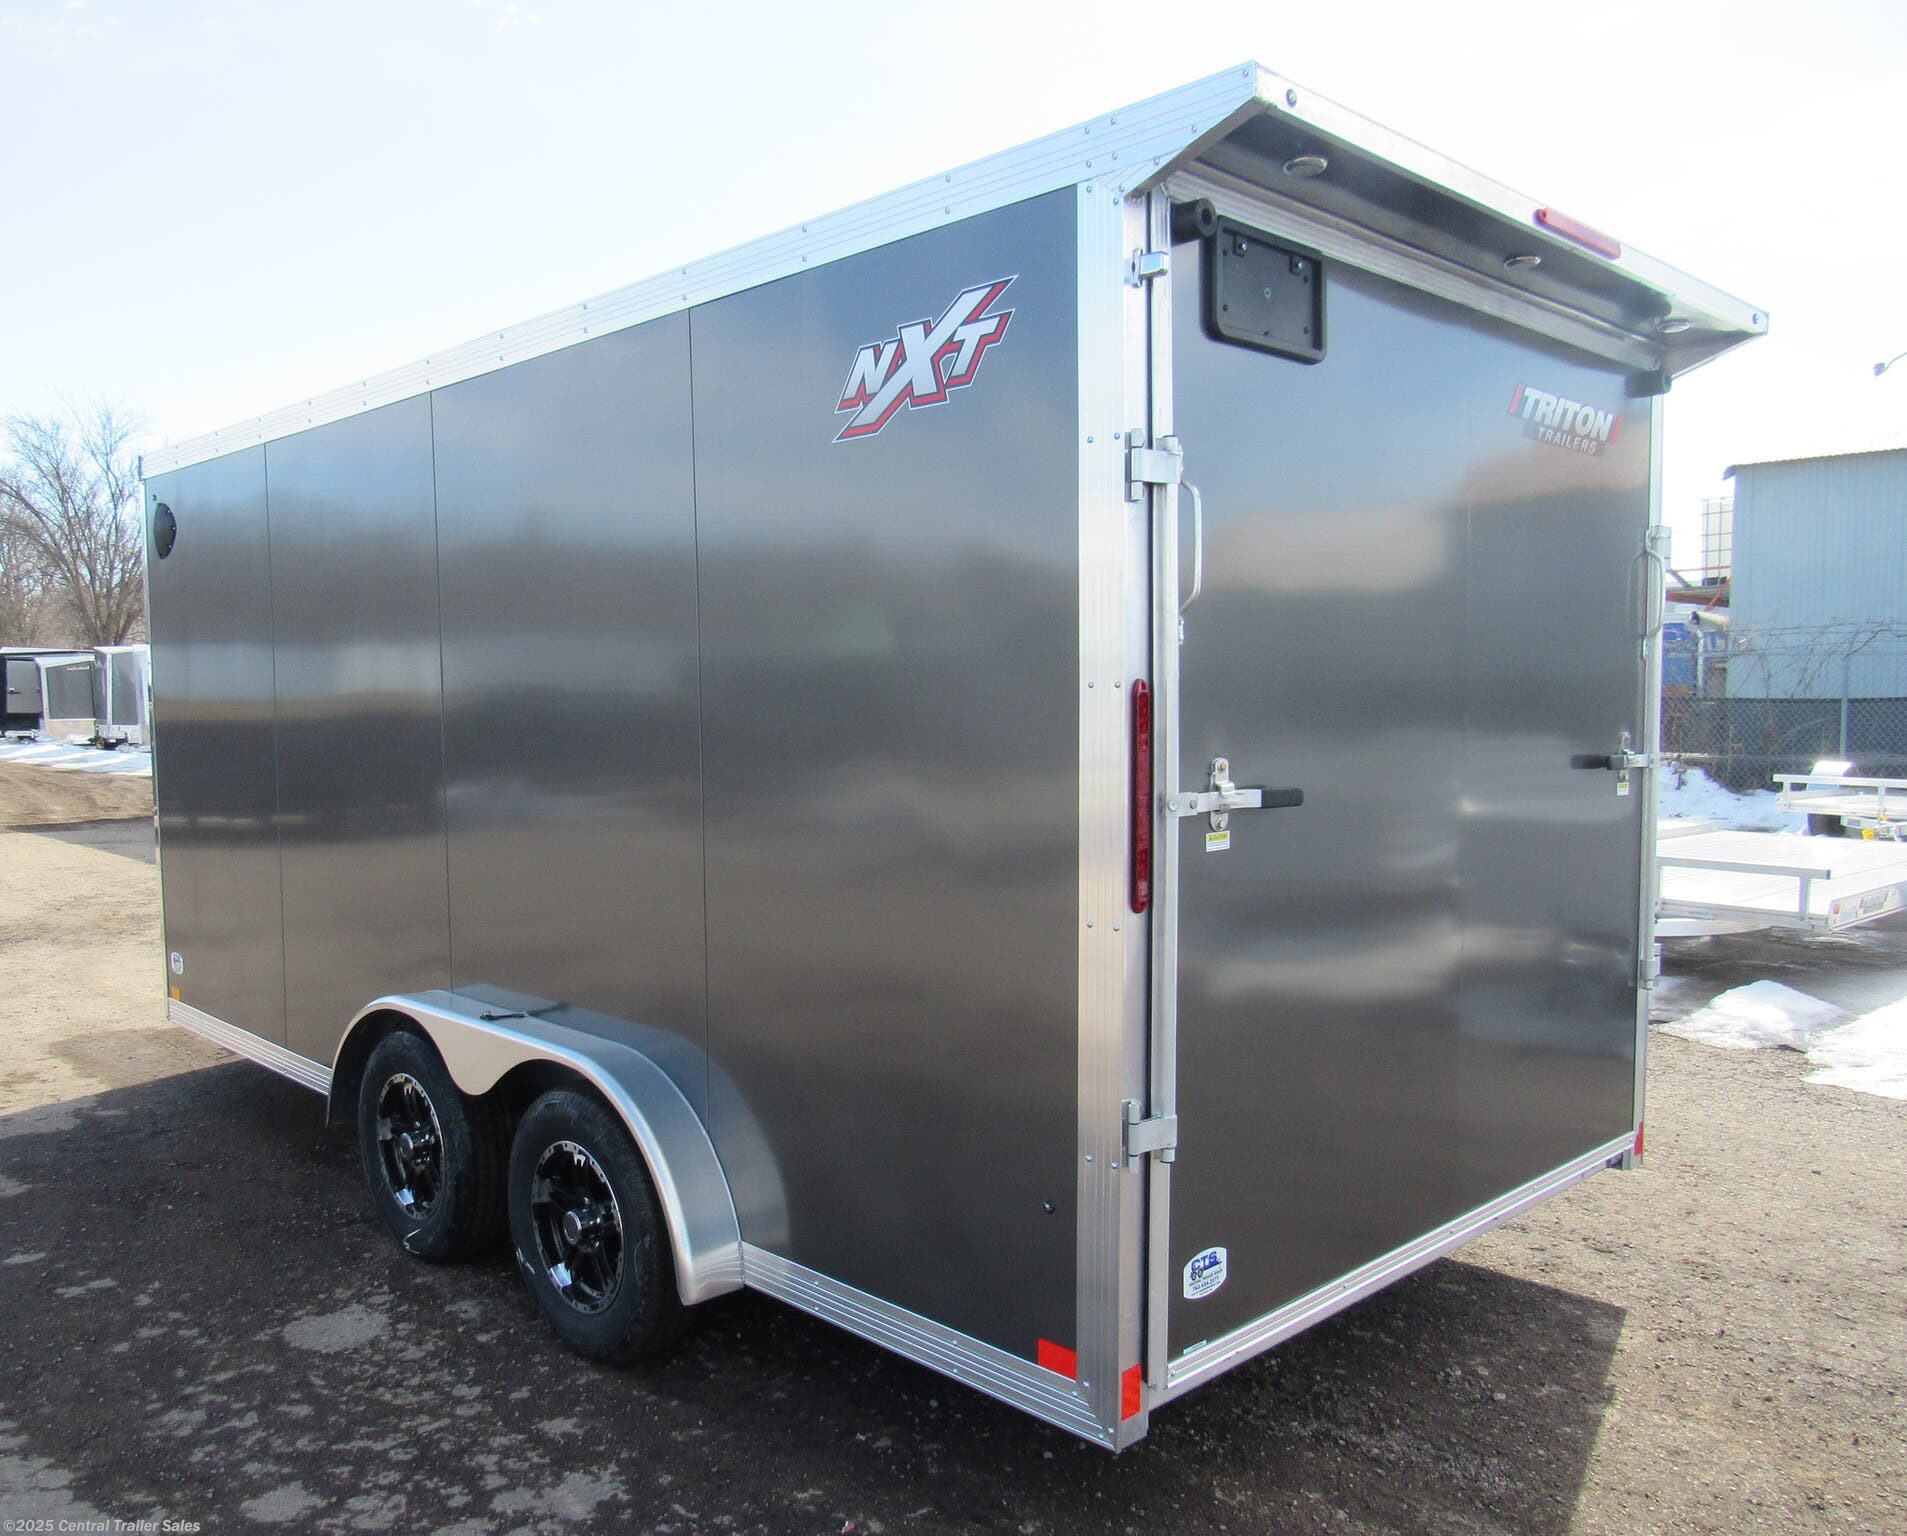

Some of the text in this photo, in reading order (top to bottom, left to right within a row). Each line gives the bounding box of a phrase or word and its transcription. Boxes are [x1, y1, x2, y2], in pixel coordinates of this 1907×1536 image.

[833, 274, 1019, 443] NXT
[1521, 386, 1615, 441] TRITON
[1537, 426, 1597, 454] TRAILERS
[1191, 1251, 1218, 1271] CTS
